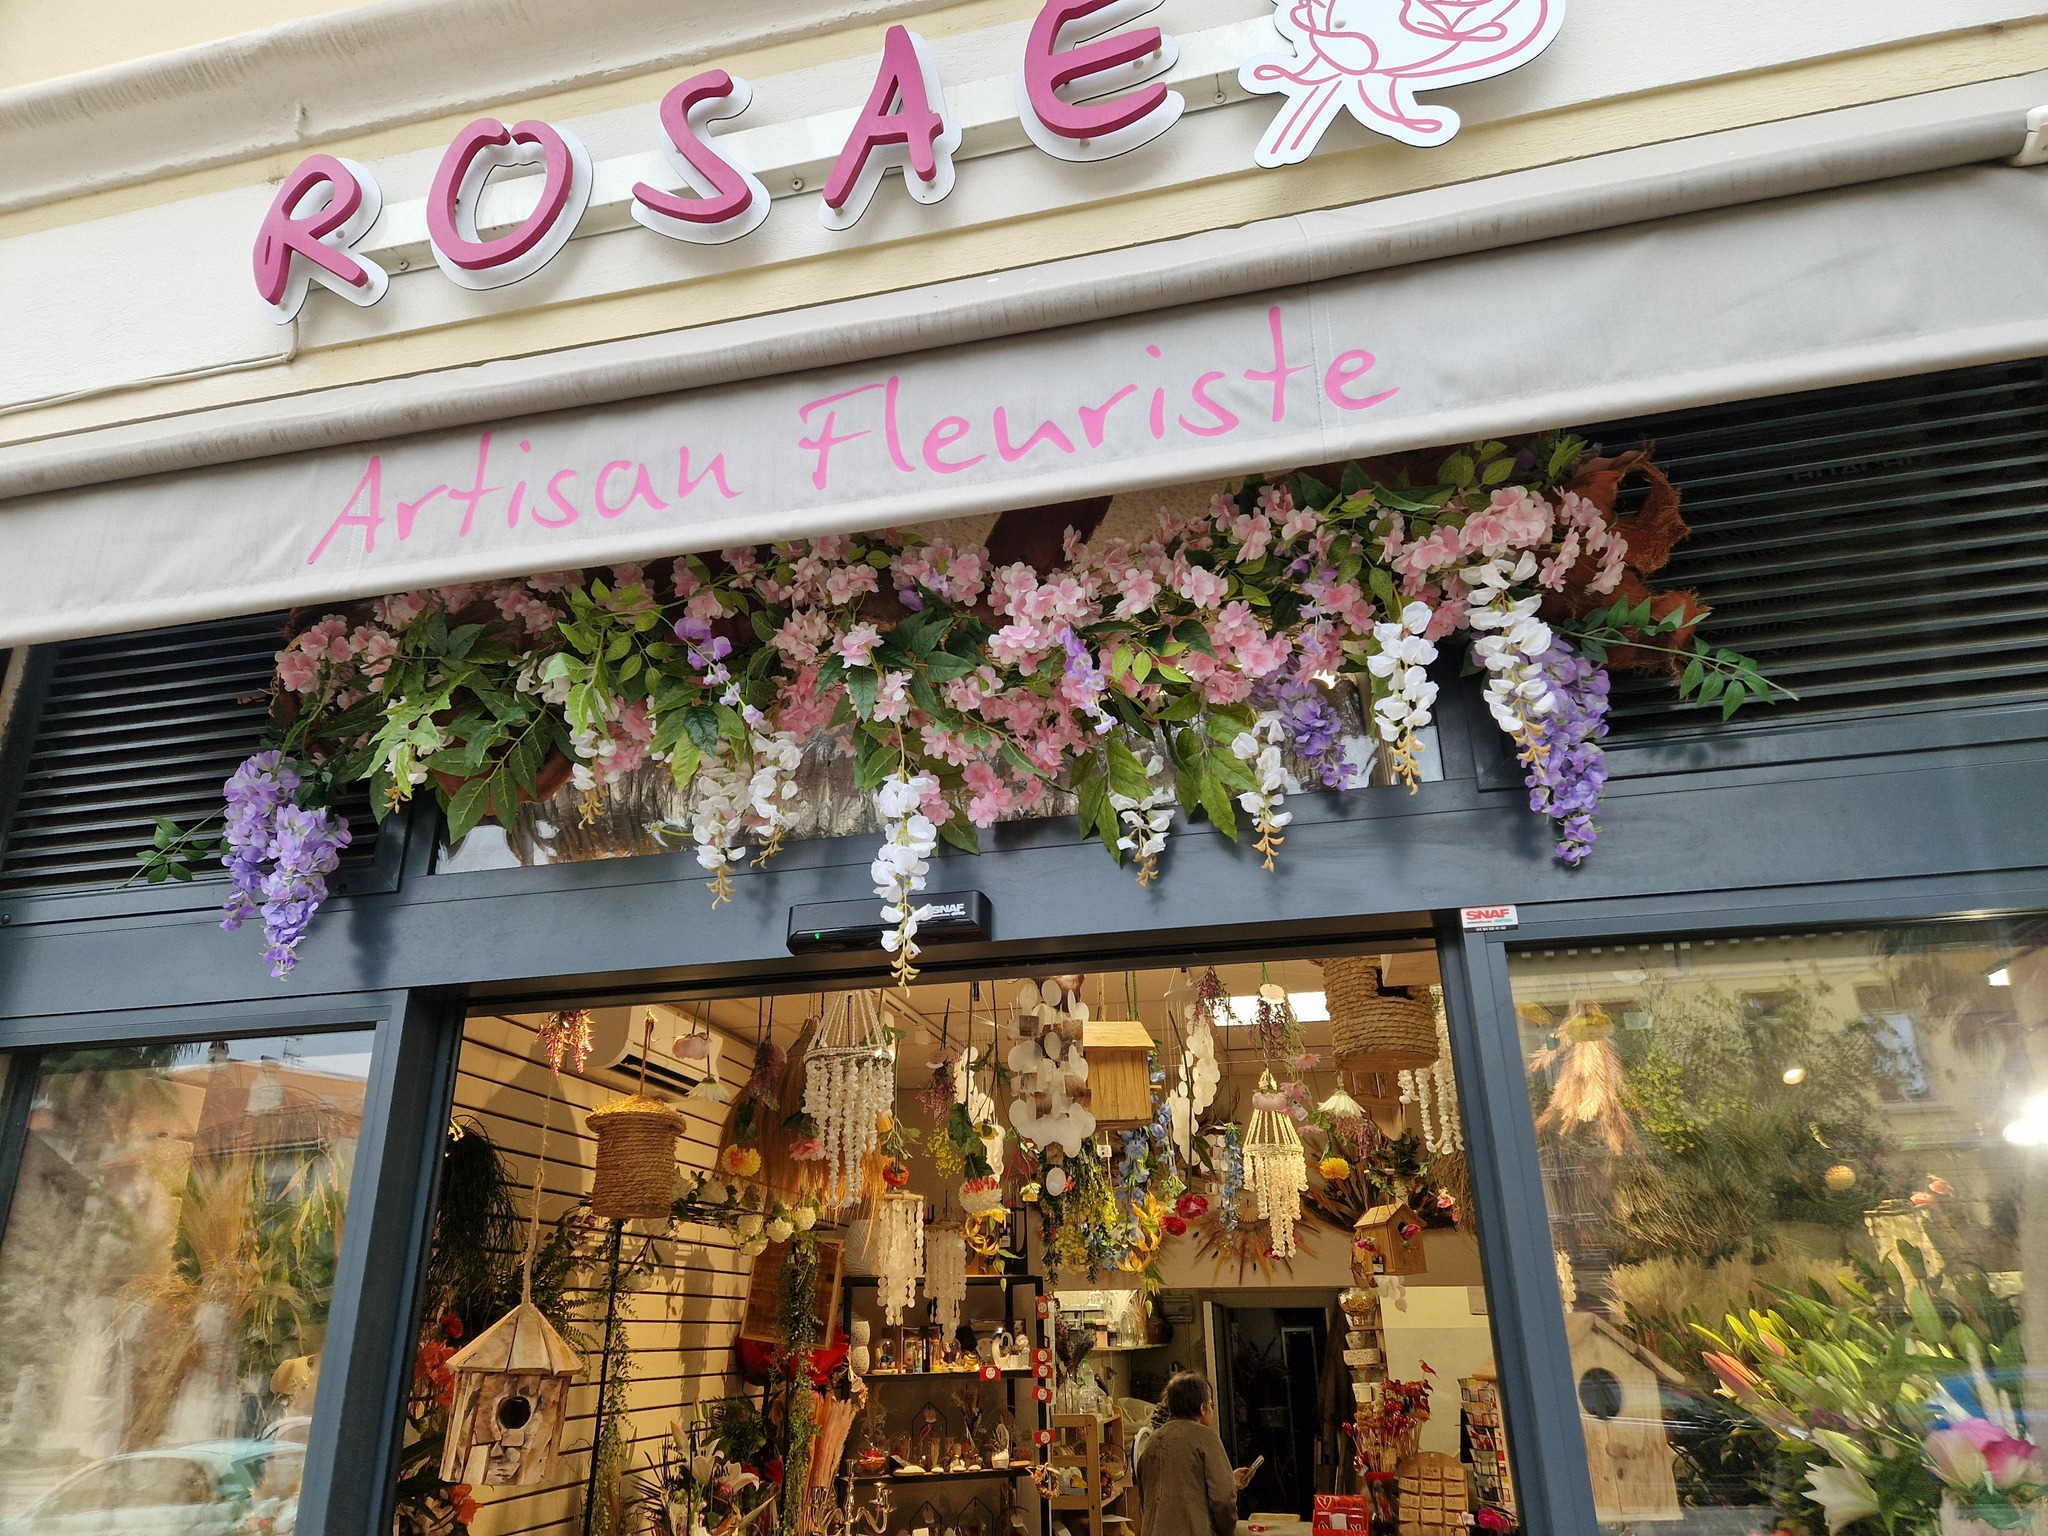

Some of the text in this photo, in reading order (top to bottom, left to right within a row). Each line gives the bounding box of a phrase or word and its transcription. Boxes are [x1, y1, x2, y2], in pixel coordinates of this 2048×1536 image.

[253, 0, 1168, 306] ROSAE
[308, 305, 1401, 564] Artisan Fleuriste
[932, 903, 965, 913] SNAF
[1465, 908, 1510, 920] SNAF
